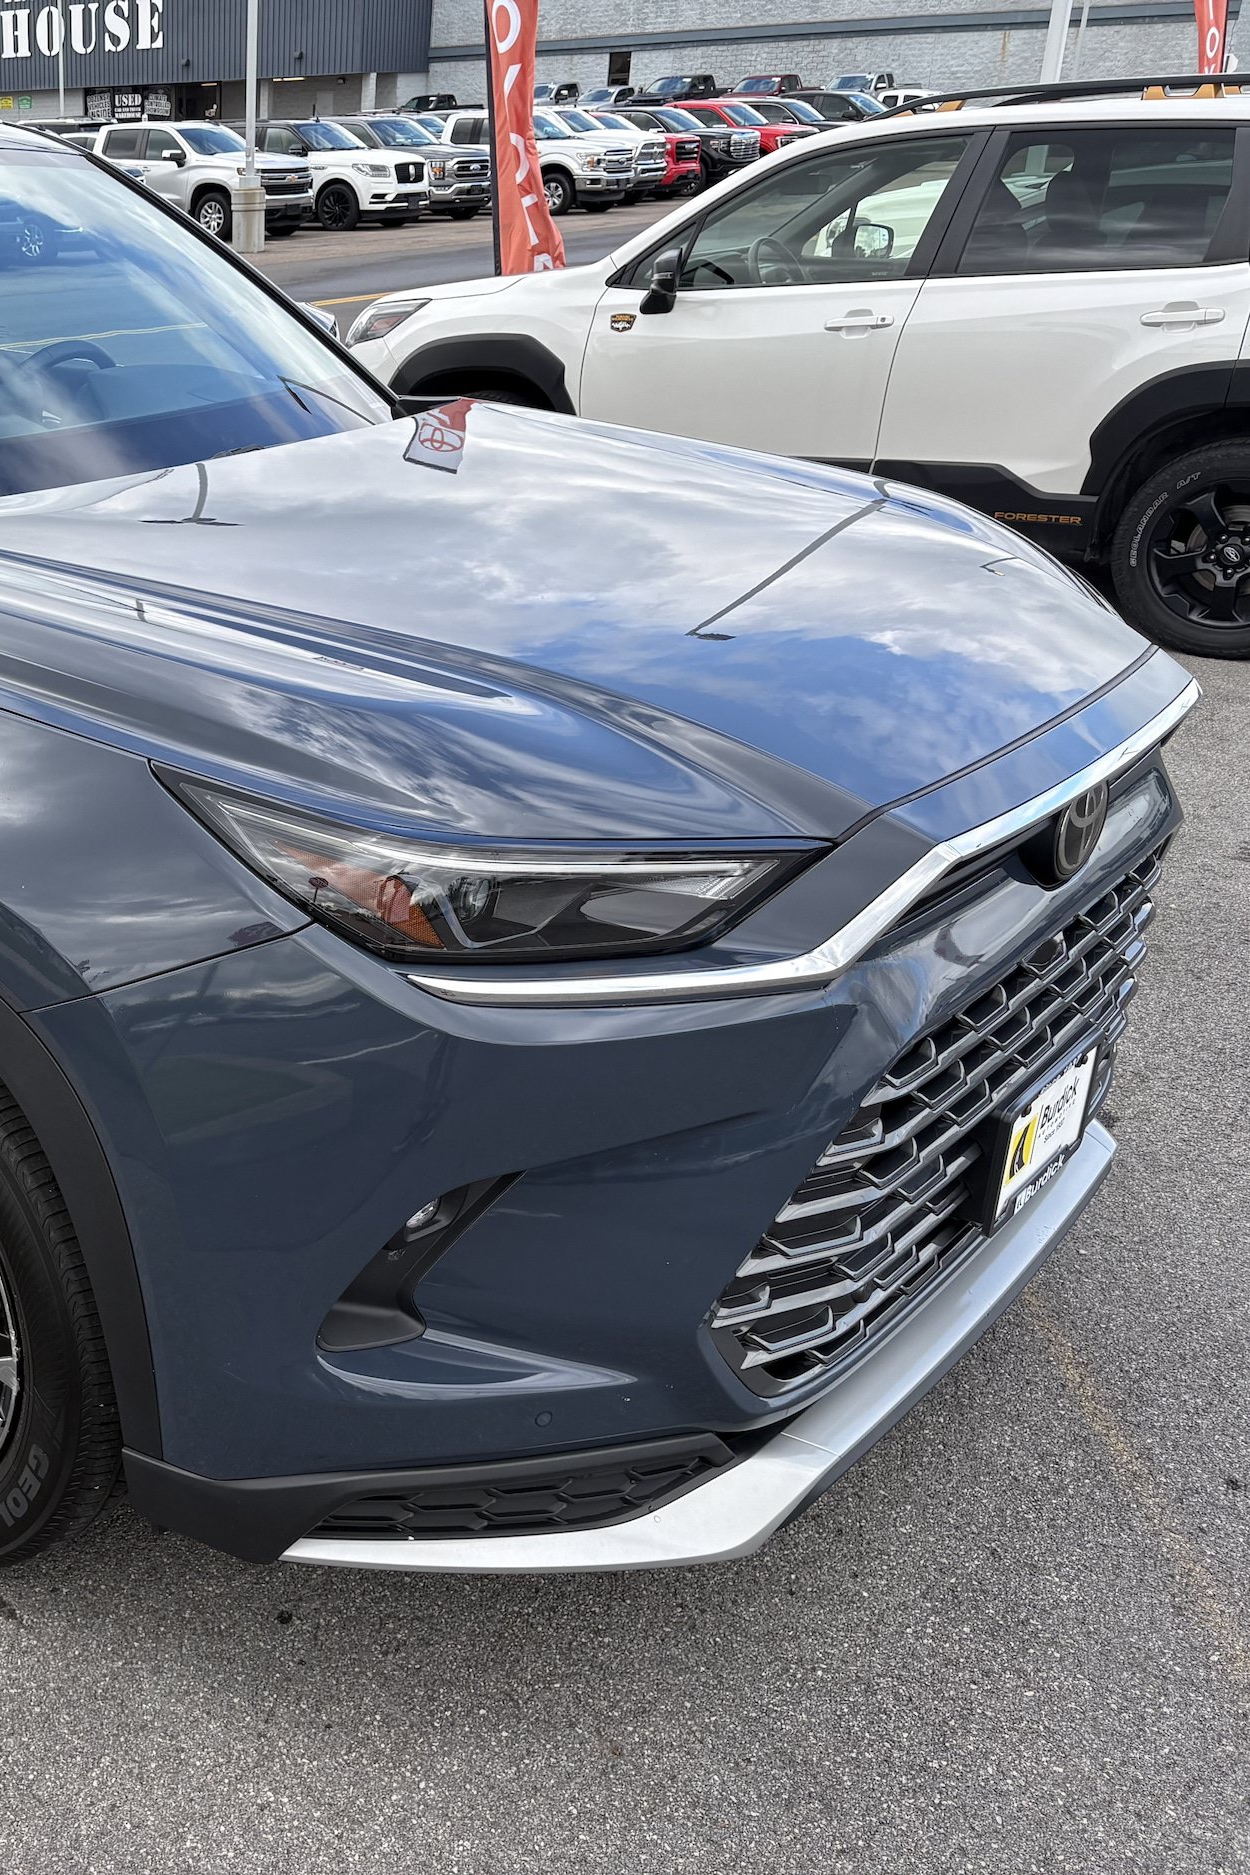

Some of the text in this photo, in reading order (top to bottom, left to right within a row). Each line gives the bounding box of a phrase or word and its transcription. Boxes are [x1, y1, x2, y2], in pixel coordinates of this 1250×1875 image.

[114, 94, 142, 106] USED
[994, 511, 1082, 525] FORESTER
[1129, 471, 1202, 567] GEOLANDAR A/T
[1040, 1076, 1080, 1130] Burdick
[1024, 1154, 1065, 1204] Burdick
